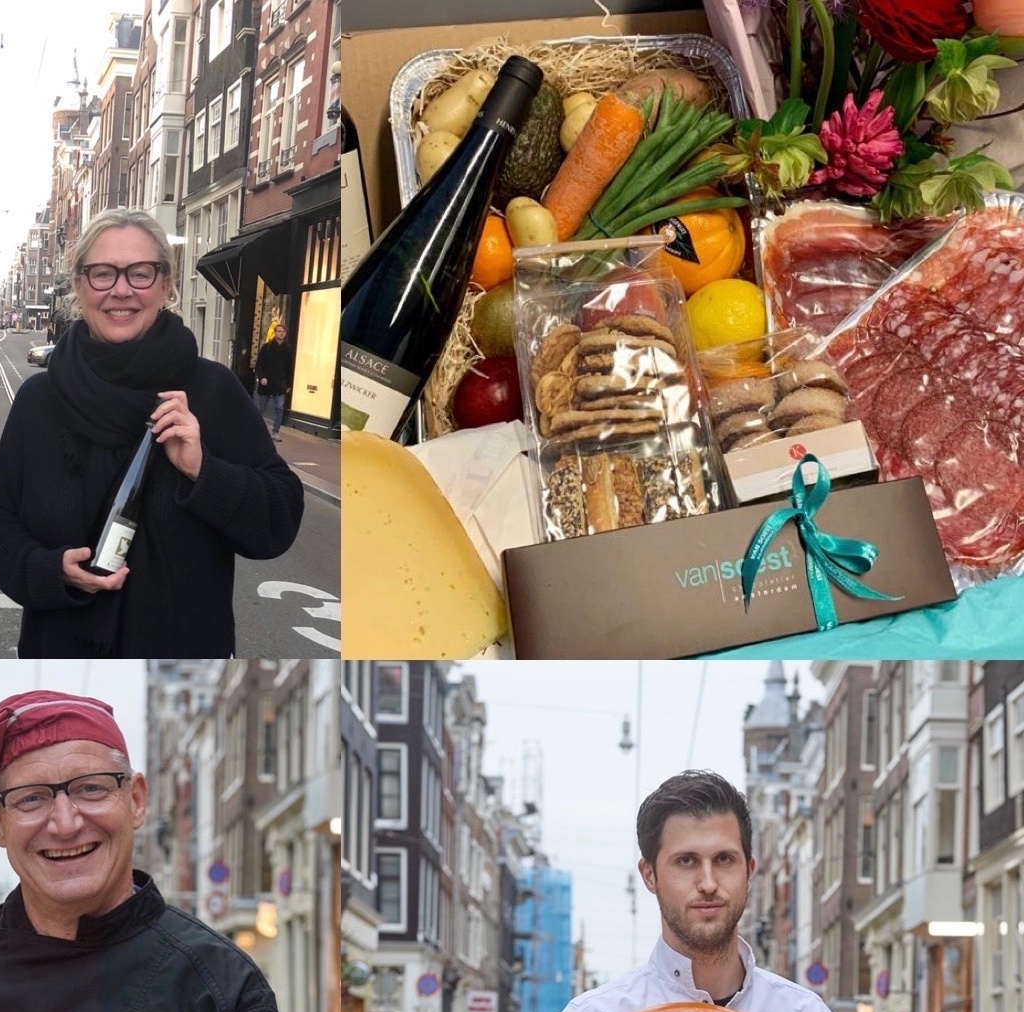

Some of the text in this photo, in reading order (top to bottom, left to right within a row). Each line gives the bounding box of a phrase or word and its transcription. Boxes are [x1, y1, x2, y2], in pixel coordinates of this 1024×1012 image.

[344, 348, 390, 376] ALSACE
[674, 564, 718, 589] van
[719, 545, 793, 580] sst
